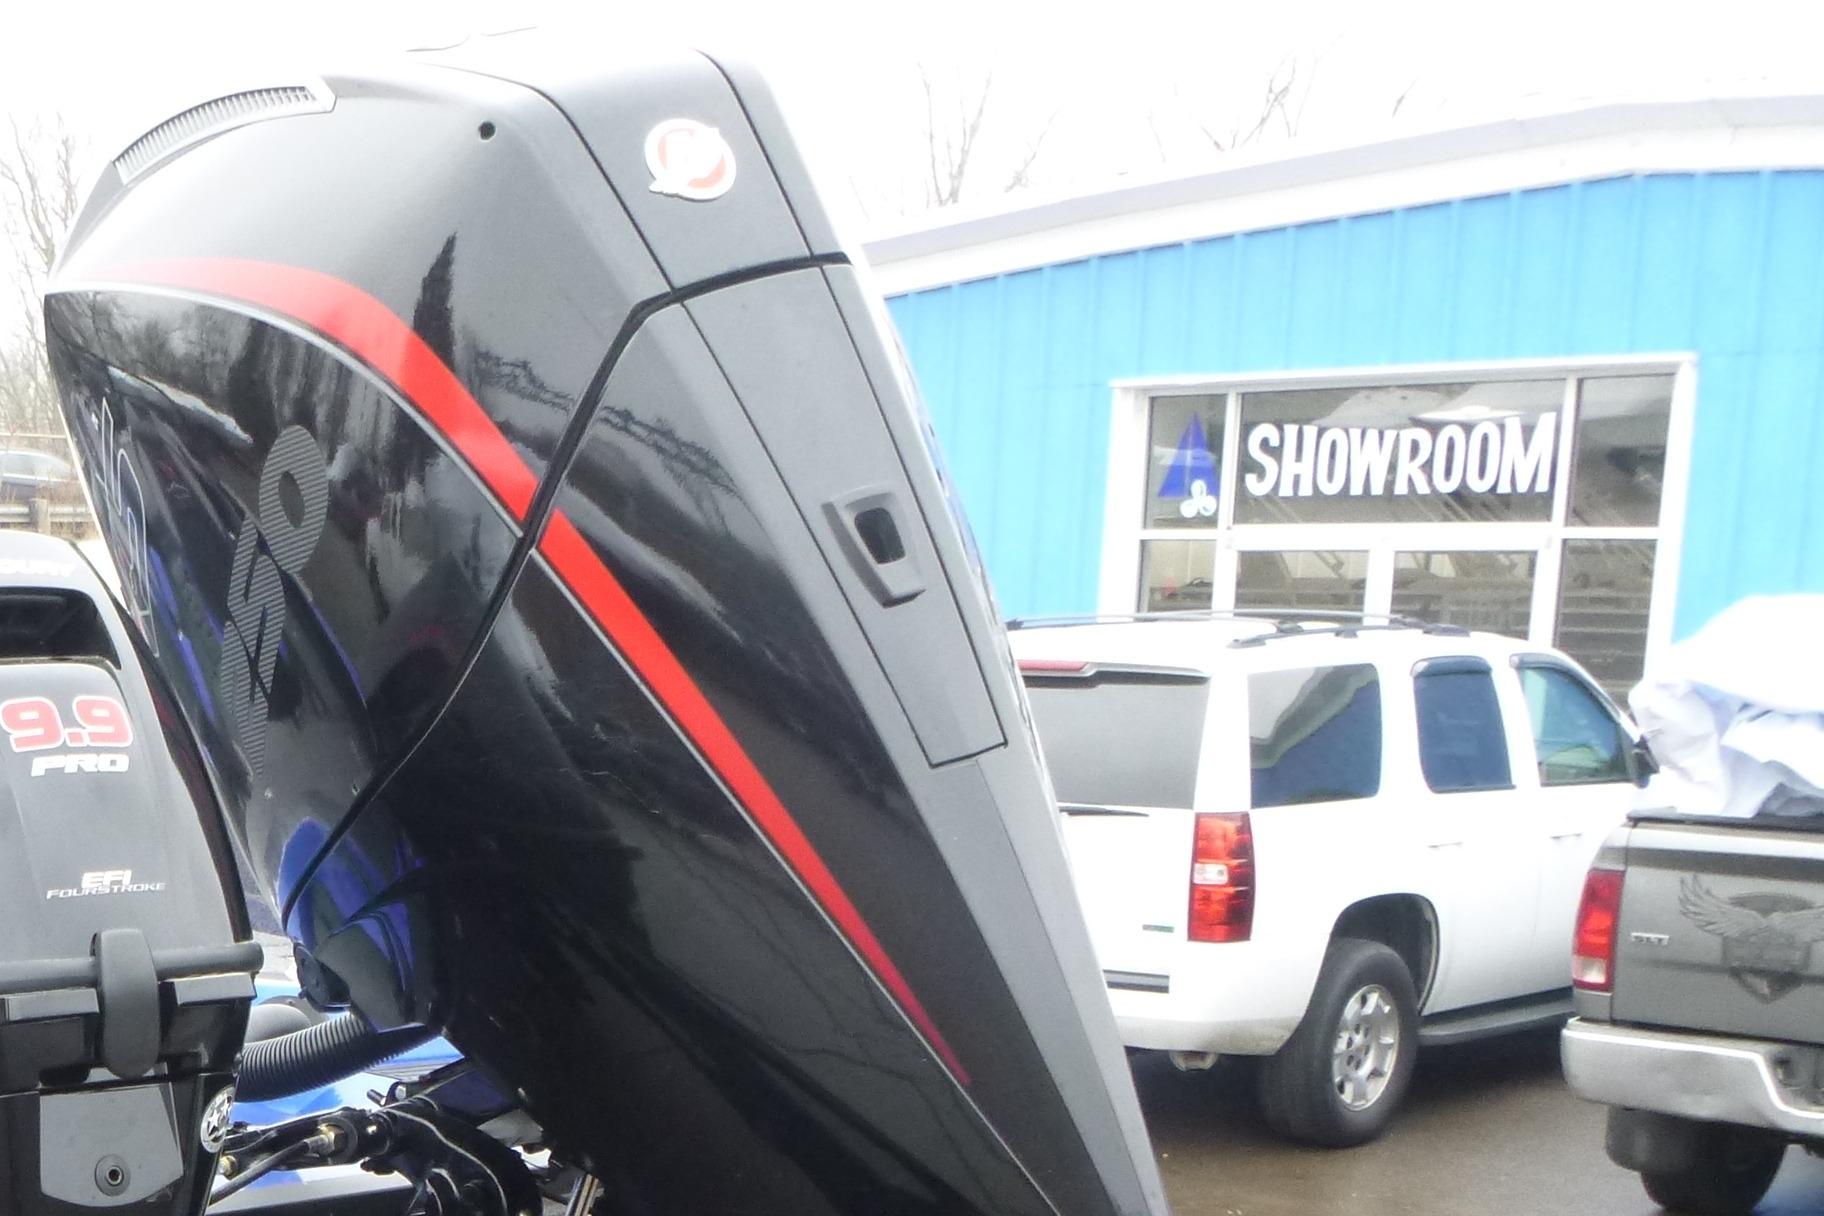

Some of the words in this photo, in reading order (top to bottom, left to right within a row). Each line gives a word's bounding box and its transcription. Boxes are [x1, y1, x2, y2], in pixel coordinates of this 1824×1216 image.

[1244, 411, 1557, 497] SHOWROOM
[31, 753, 130, 777] PRO
[81, 869, 133, 890] EFI
[45, 882, 166, 900] FOURSTROKE
